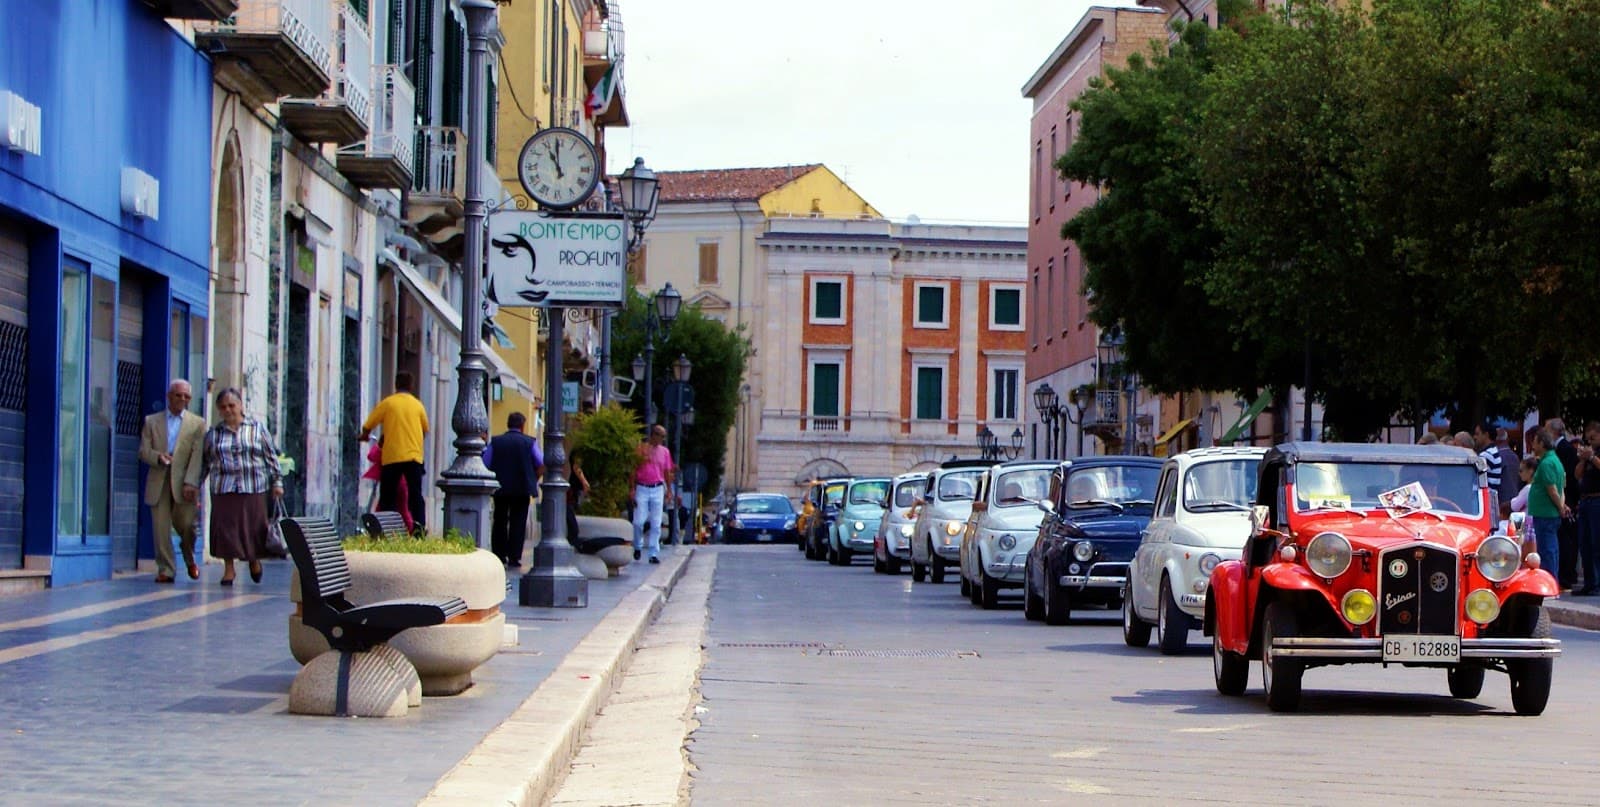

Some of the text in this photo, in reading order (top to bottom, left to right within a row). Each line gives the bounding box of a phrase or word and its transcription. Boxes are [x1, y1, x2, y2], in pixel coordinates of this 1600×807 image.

[520, 222, 621, 241] BONTEMPO
[559, 250, 620, 266] PROFUMI
[546, 280, 620, 289] CAMPOBASSO TERMOLI
